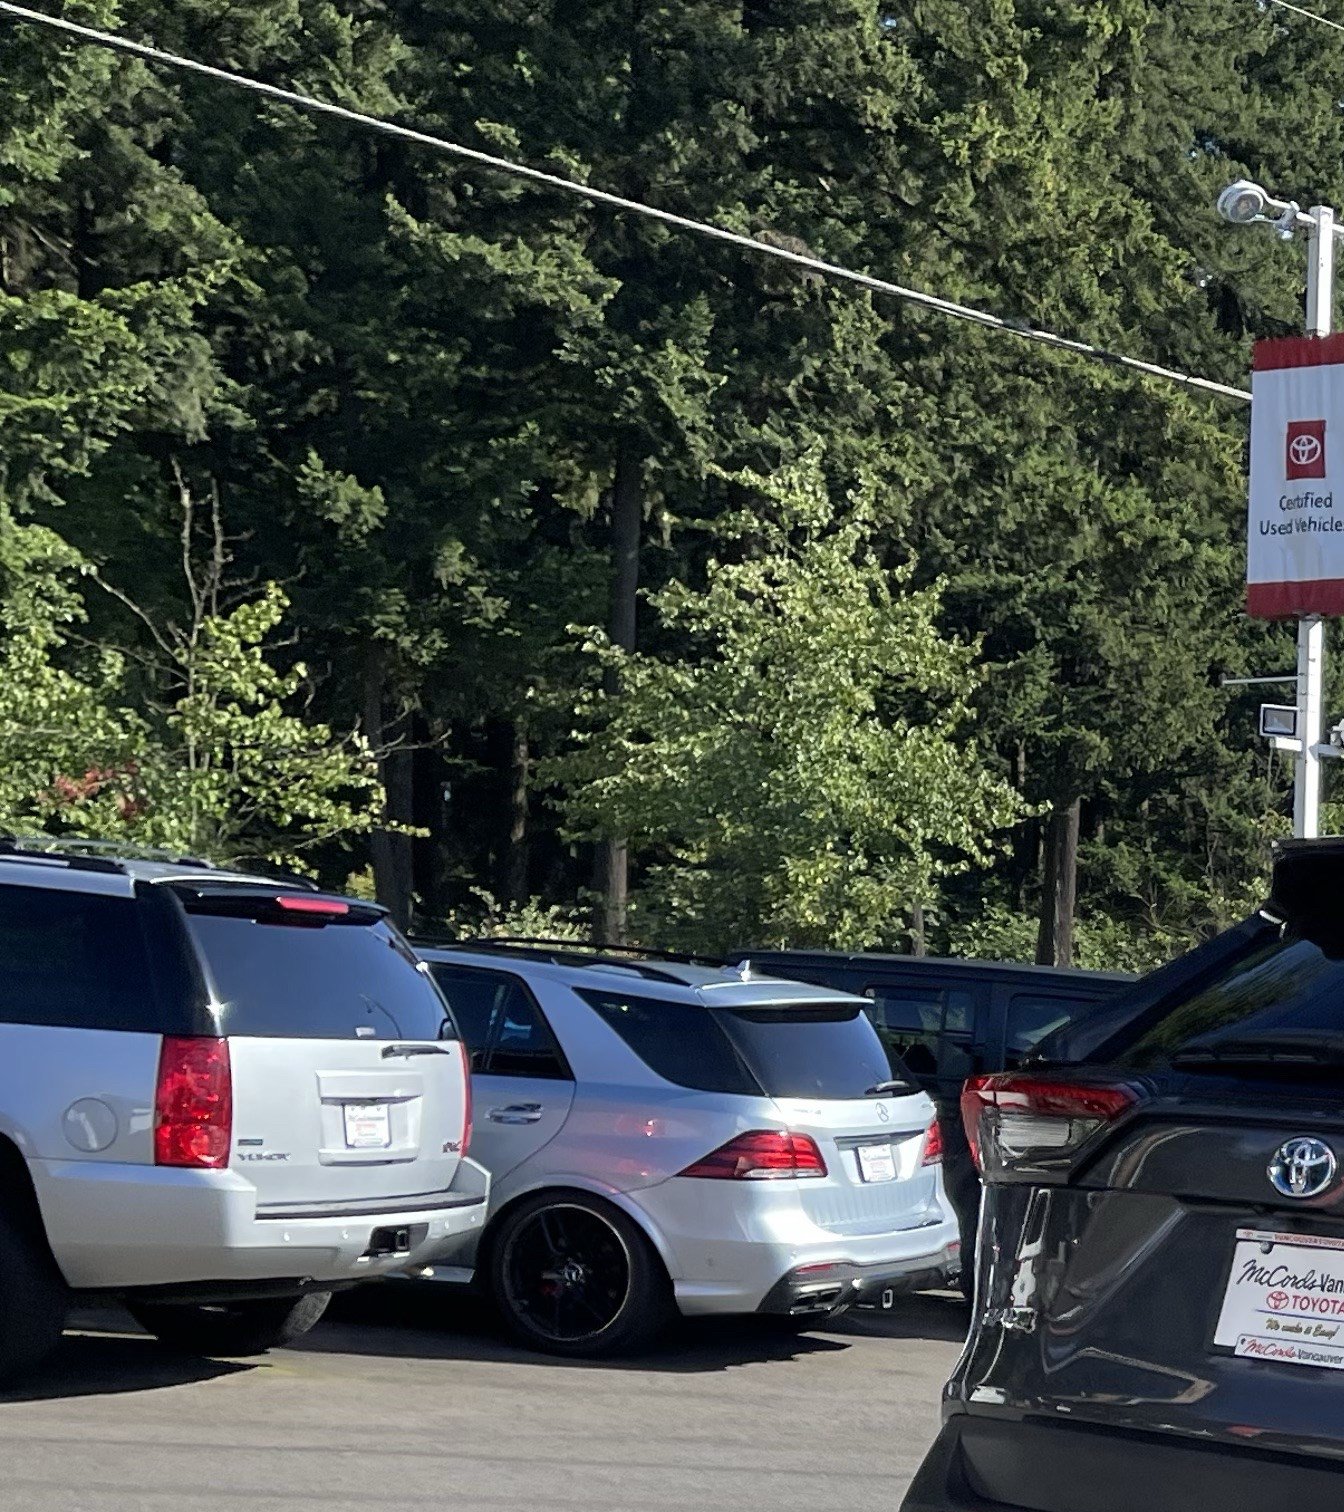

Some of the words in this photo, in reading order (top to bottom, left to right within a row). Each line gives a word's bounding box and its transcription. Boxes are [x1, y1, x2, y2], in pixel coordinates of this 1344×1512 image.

[1279, 491, 1333, 512] Certified
[1259, 519, 1293, 536] Used
[1236, 1258, 1321, 1292] McCords
